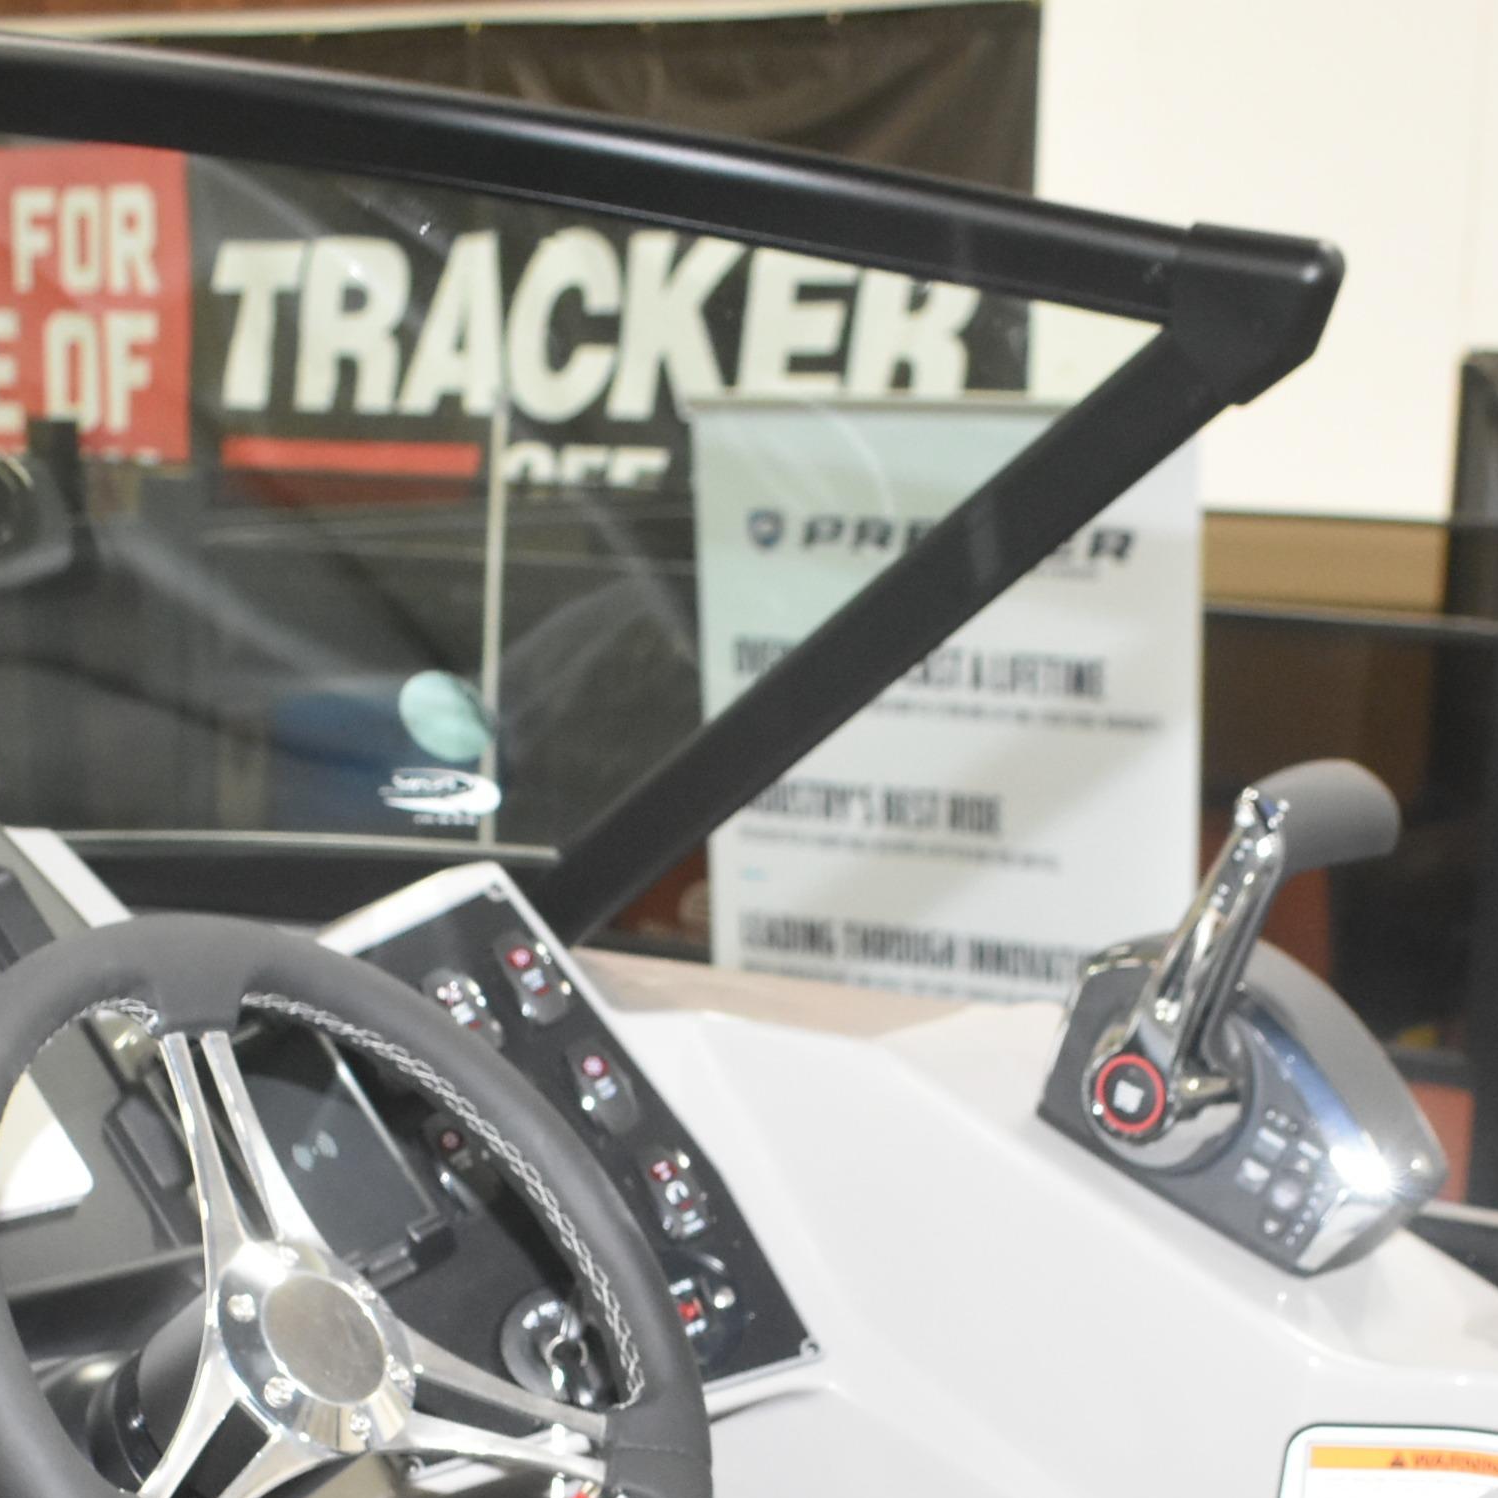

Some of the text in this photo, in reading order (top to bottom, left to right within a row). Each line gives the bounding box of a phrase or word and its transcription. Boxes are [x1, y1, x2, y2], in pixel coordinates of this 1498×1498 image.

[9, 183, 160, 295] FOR
[43, 308, 159, 434] OF
[211, 224, 981, 424] TRACKER
